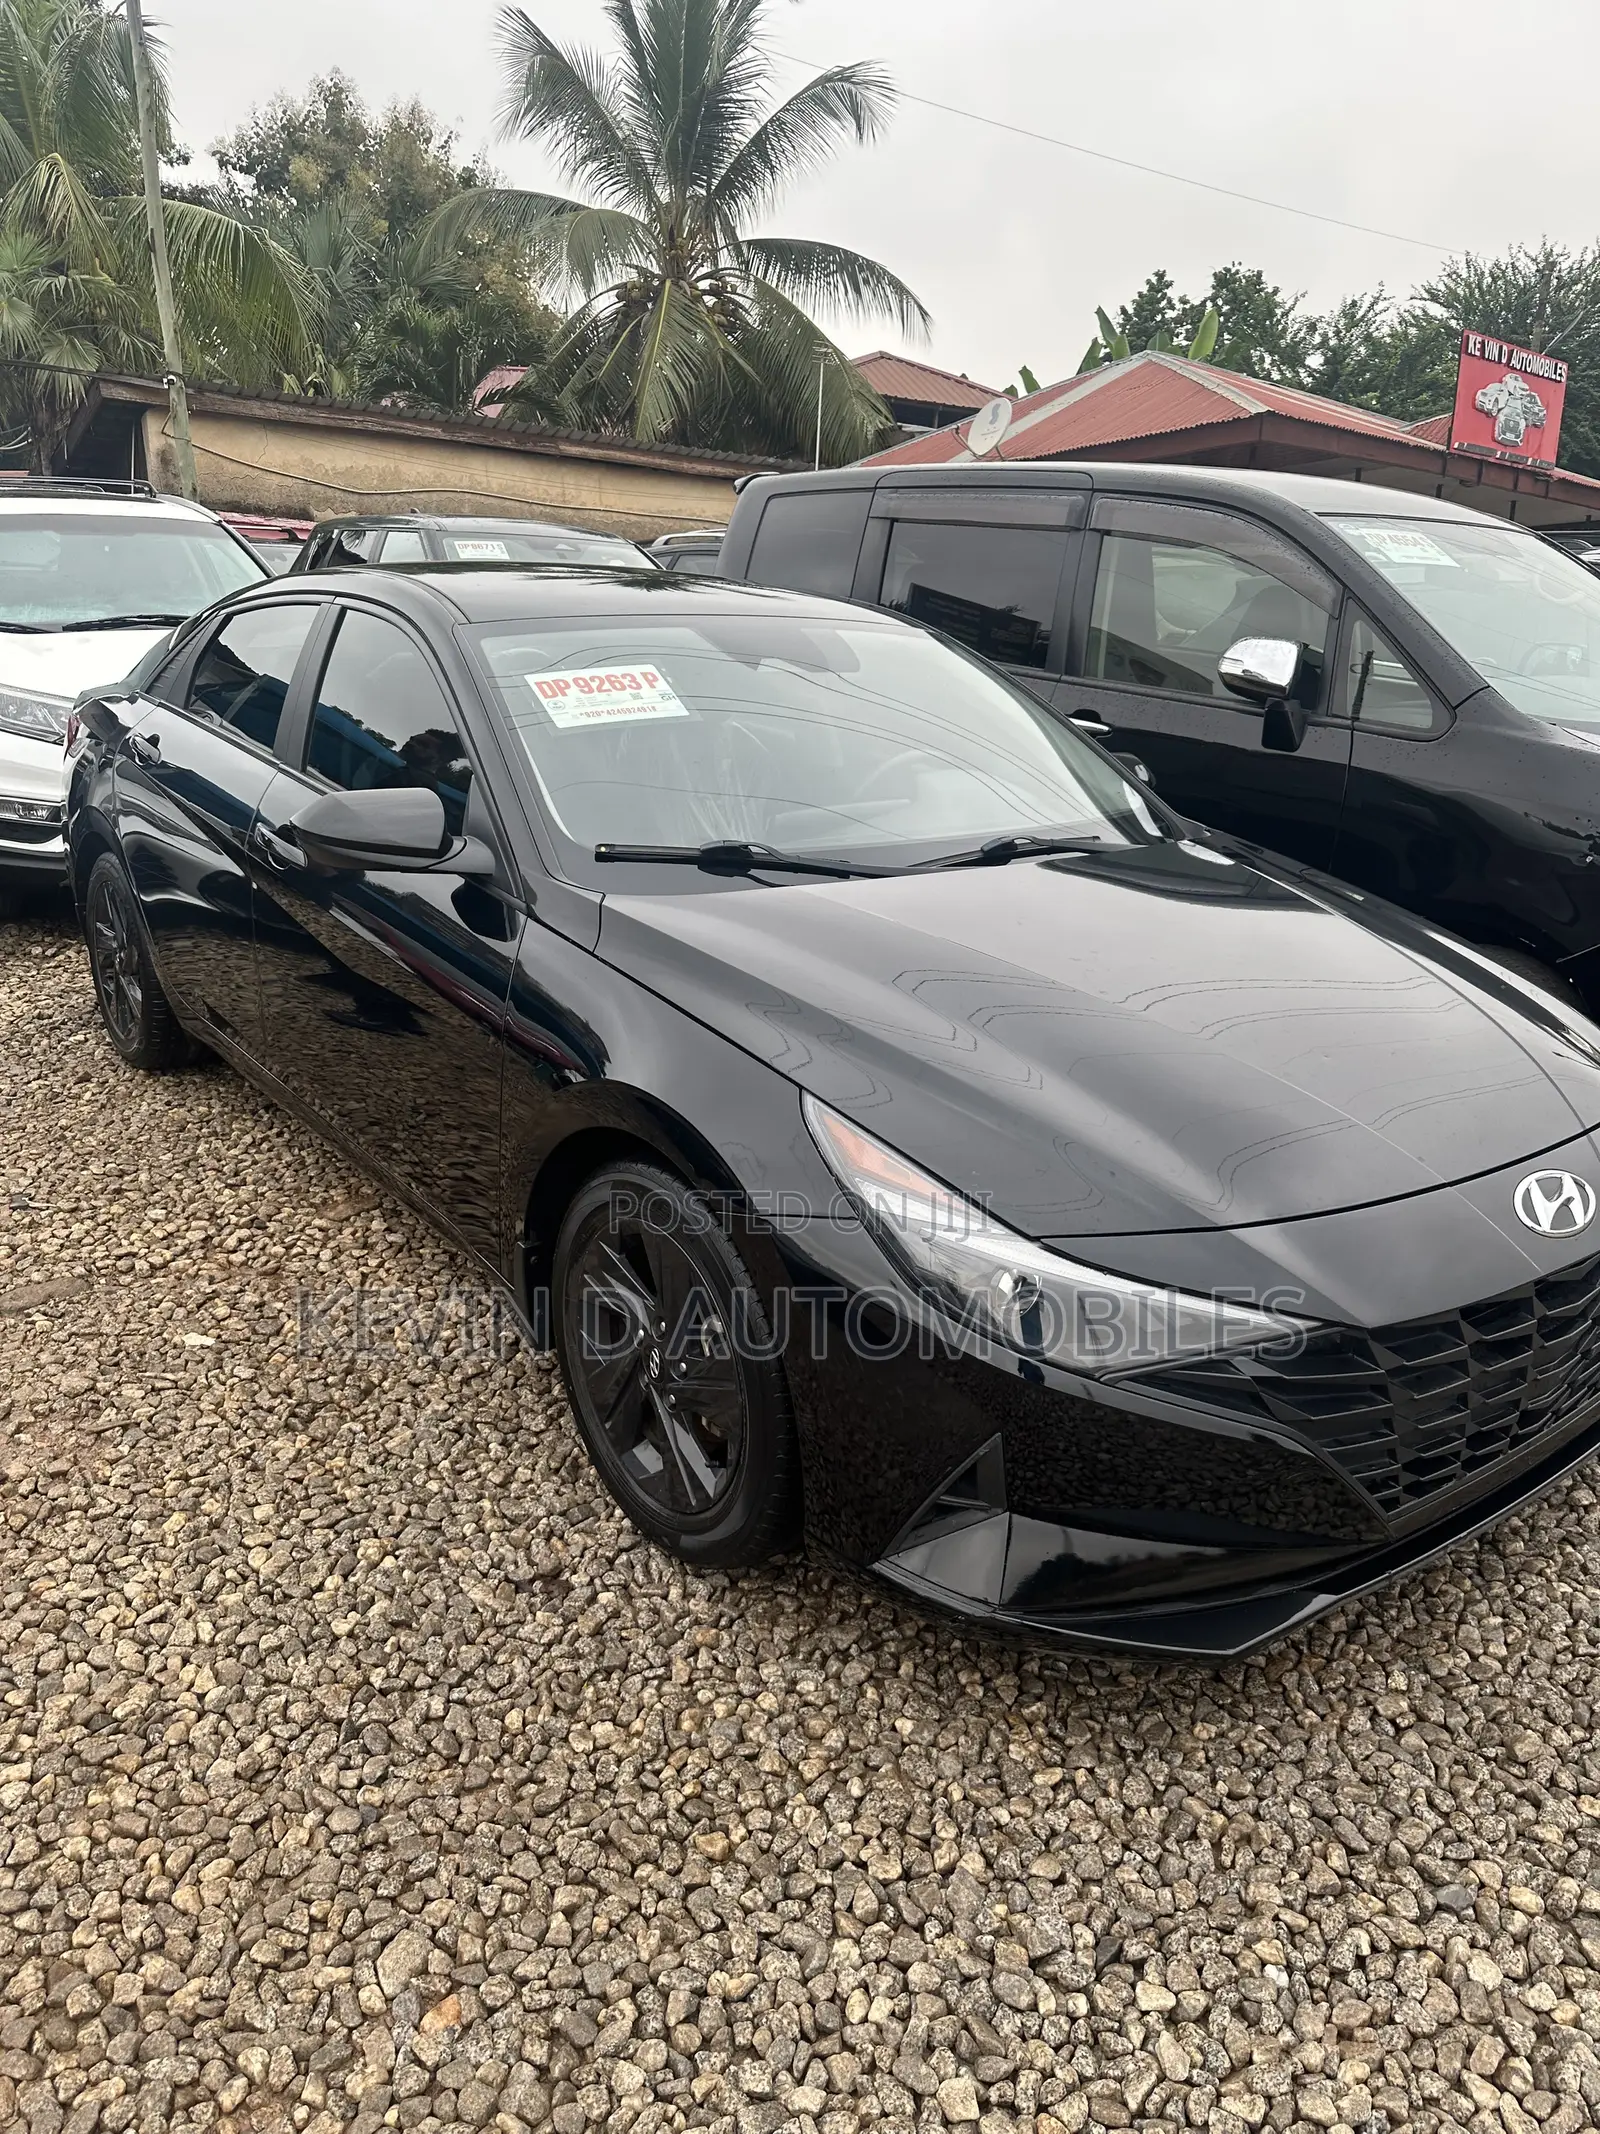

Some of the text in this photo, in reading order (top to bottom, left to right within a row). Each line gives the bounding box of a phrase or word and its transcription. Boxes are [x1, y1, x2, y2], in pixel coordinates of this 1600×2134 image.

[1510, 349, 1567, 383] AUTOMOBILES
[534, 671, 659, 699] DP 9263 P
